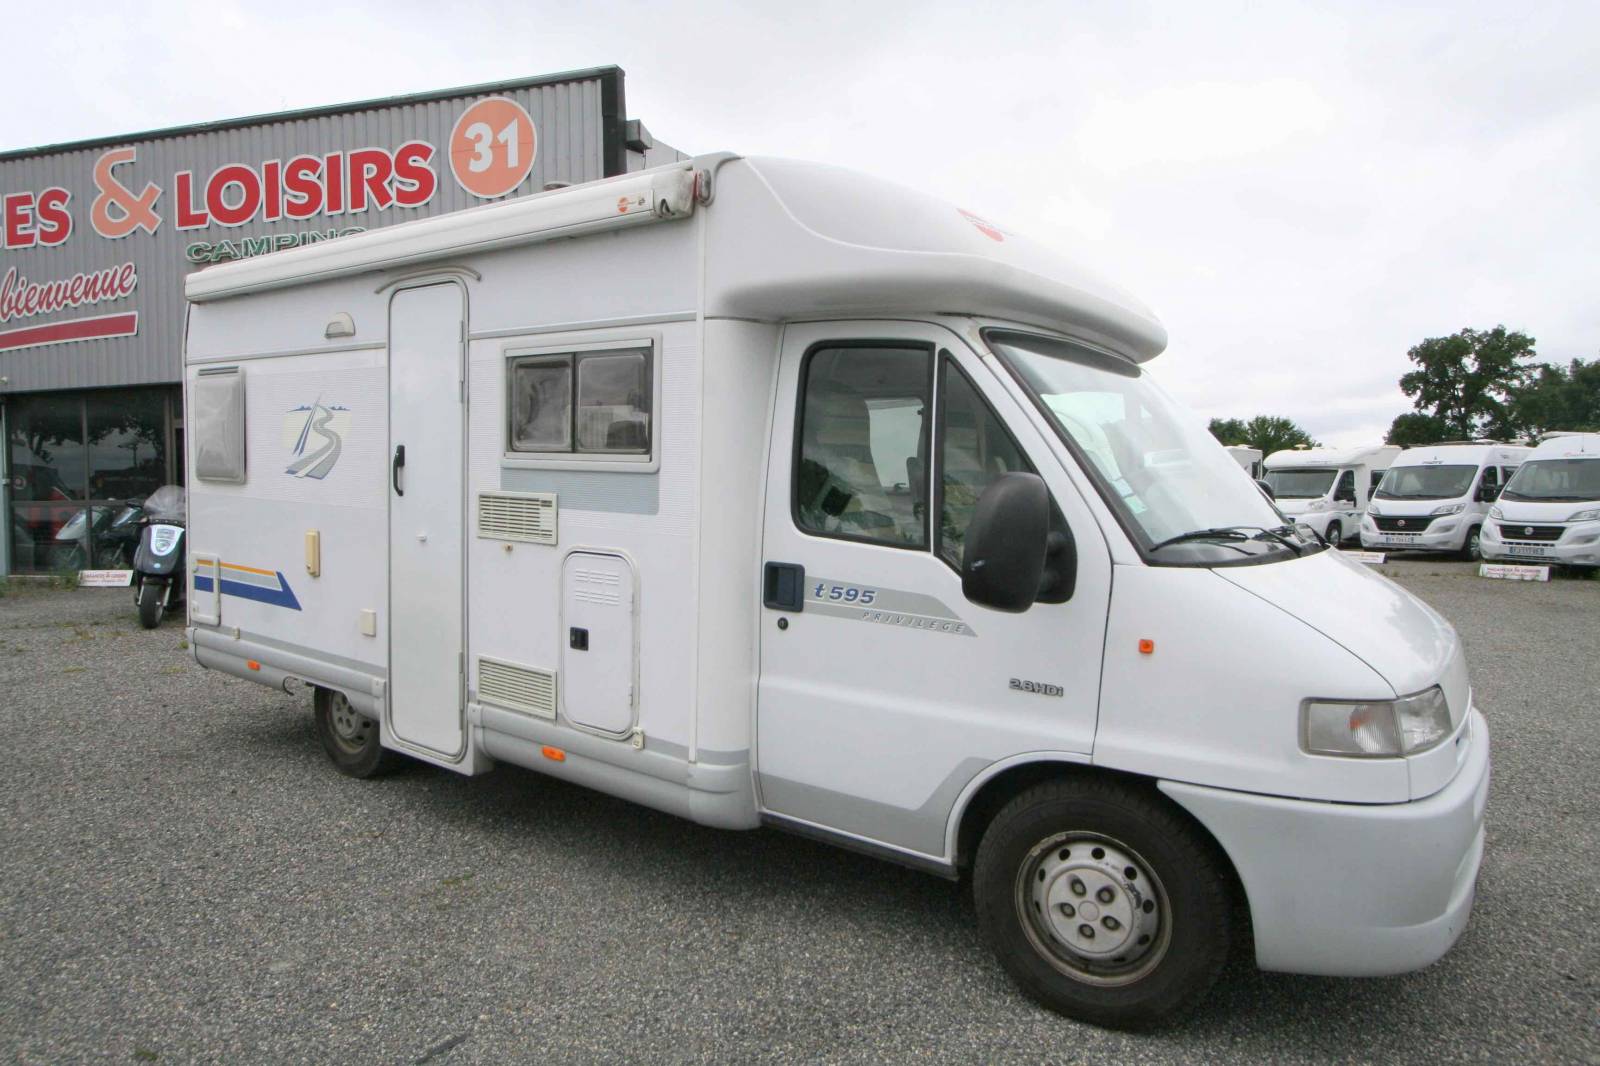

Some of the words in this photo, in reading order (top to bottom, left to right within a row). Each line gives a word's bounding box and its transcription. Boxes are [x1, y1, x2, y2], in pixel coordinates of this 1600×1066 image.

[0, 187, 72, 249] ES
[91, 147, 163, 238] &
[174, 140, 437, 230] LOISIRS
[464, 118, 518, 173] 31
[185, 226, 368, 263] CAMPIN
[0, 262, 137, 322] bienvenue
[862, 611, 965, 633] PRIVILEGE
